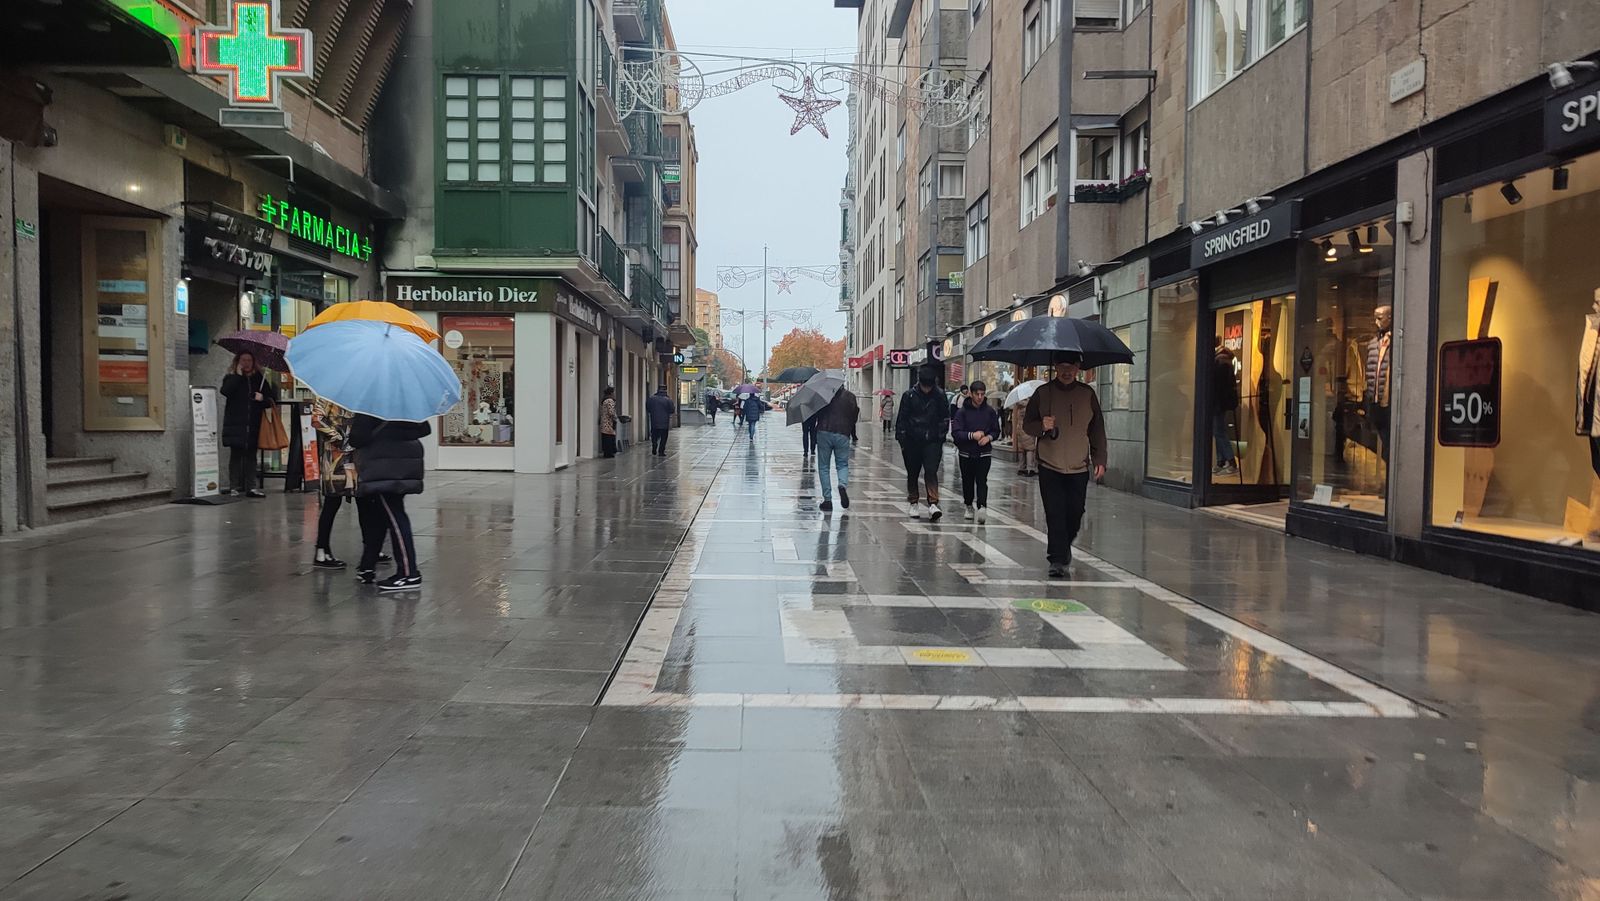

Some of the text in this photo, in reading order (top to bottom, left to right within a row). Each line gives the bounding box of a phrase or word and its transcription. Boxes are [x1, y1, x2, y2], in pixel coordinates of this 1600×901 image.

[280, 200, 360, 259] FARMACIA
[1204, 219, 1271, 257] SPRINGFIELD
[396, 284, 494, 302] Herbolario
[497, 286, 538, 303] Diez
[1444, 391, 1493, 424] -50%
